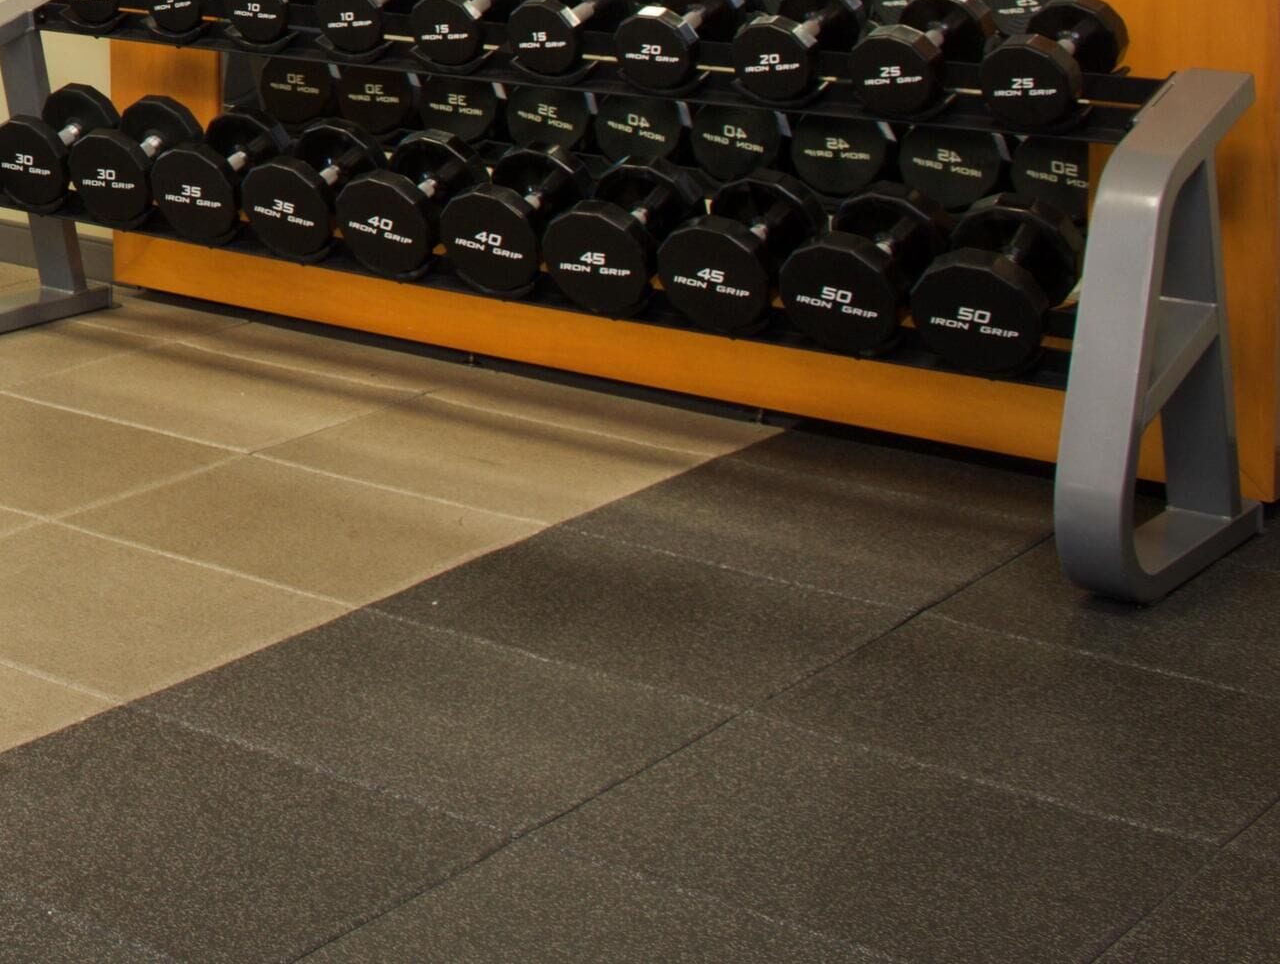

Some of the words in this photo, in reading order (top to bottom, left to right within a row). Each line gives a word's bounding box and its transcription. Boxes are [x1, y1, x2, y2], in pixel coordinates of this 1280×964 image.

[174, 0, 192, 8] GRIP
[247, 2, 260, 12] 10
[257, 12, 277, 20] GRIP
[340, 12, 354, 22] 10
[435, 24, 450, 34] 15
[532, 31, 547, 42] 15
[640, 44, 662, 55] 20
[625, 52, 649, 61] IRON
[655, 55, 680, 63] GRIP
[759, 53, 780, 65] 20
[744, 65, 770, 73] IRON
[775, 63, 800, 71] GRIP
[880, 66, 901, 78] 25
[864, 78, 890, 86] IRON
[896, 76, 922, 84] GRIP
[1011, 78, 1034, 89] 25
[994, 89, 1022, 97] IRON
[1028, 88, 1057, 96] GRIP
[15, 153, 34, 166] 30
[1, 162, 24, 172] IRON
[28, 166, 51, 176] GRIP
[96, 168, 116, 181] 30
[82, 179, 106, 187] IRON
[111, 181, 135, 190] GRIP
[181, 184, 202, 198] 35
[165, 194, 190, 204] IRON
[196, 199, 222, 208] GRIP
[272, 198, 295, 214] 35
[254, 205, 281, 218] IRON
[287, 215, 314, 227] GRIP
[367, 216, 393, 231] 40
[348, 221, 377, 234] IRON
[384, 232, 413, 244] GRIP
[474, 231, 502, 246] 40
[455, 237, 486, 251] IRON
[492, 247, 523, 259] GRIP
[579, 251, 606, 265] 45
[559, 262, 591, 273] IRON
[599, 266, 631, 276] GRIP
[696, 268, 725, 284] 45
[673, 275, 708, 289] IRON
[716, 284, 750, 297] GRIP
[820, 286, 852, 304] 50
[796, 294, 832, 309] IRON
[841, 305, 878, 318] GRIP
[957, 306, 991, 324] 50
[930, 316, 970, 330] IRON
[979, 325, 1019, 338] GRIP
